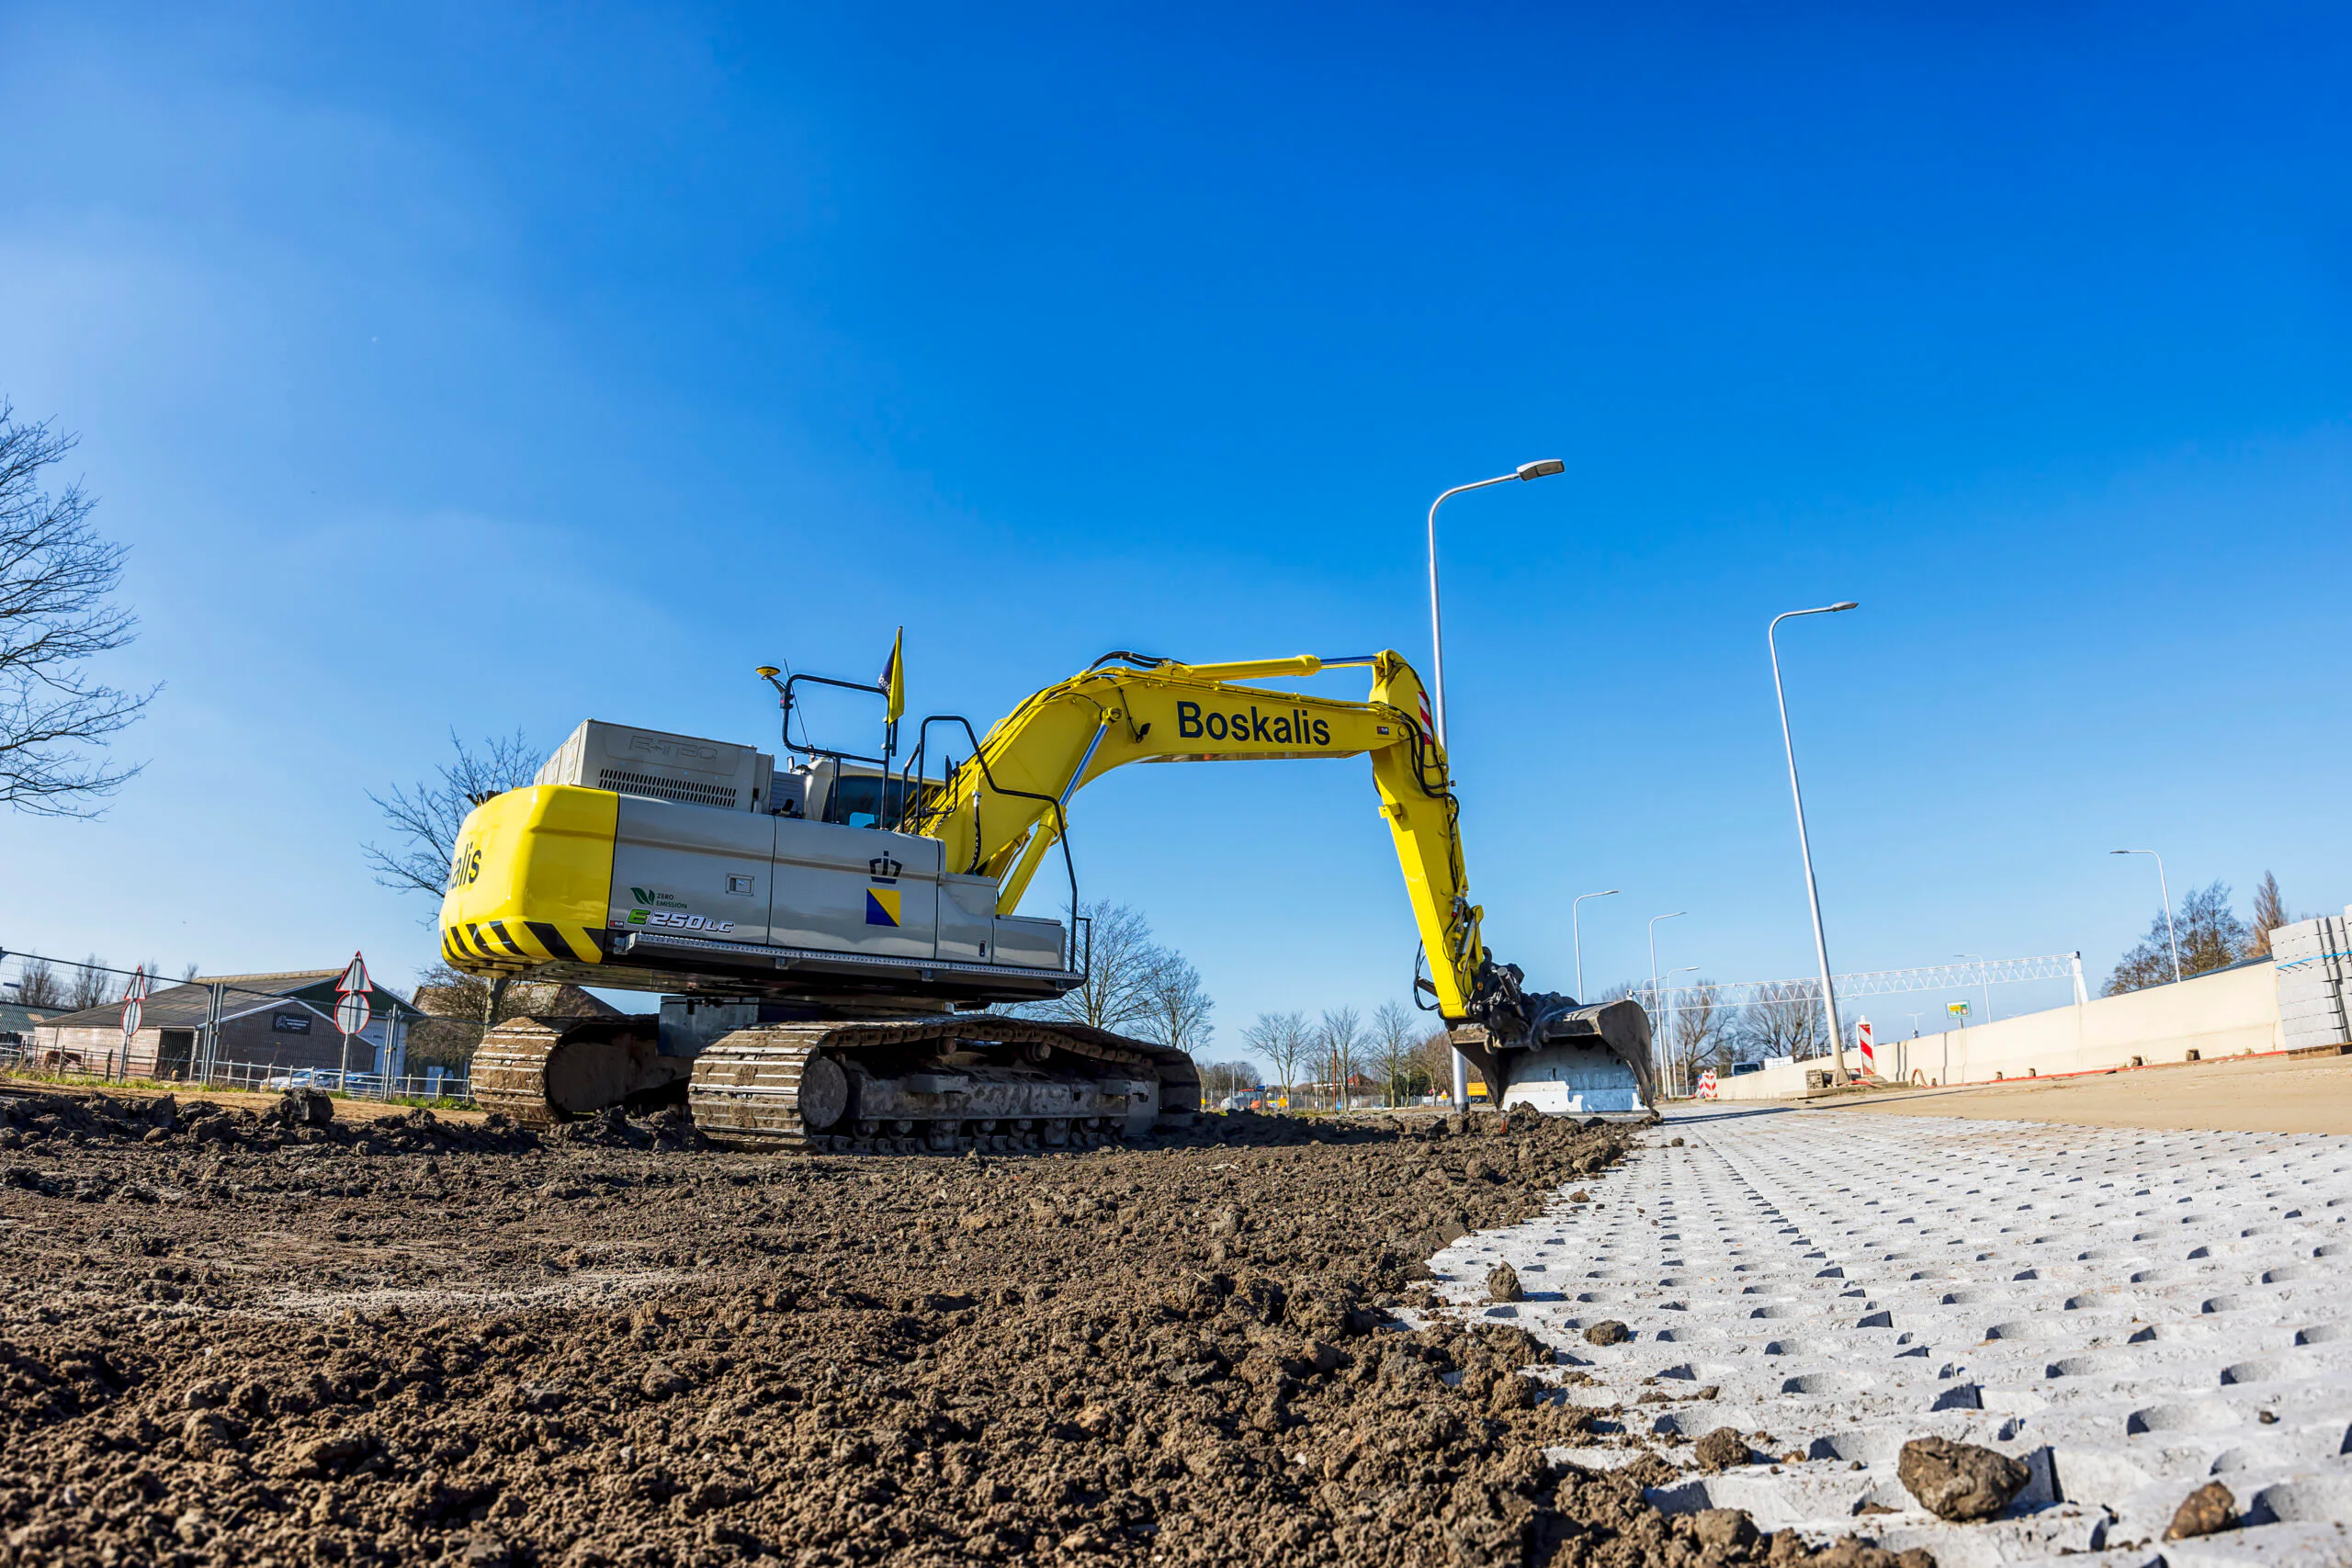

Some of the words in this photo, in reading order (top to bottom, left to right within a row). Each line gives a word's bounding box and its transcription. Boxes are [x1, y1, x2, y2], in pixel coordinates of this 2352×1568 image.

[1177, 701, 1330, 746] Boskalis
[656, 892, 674, 900] ZERO
[656, 900, 688, 909] EMISSION
